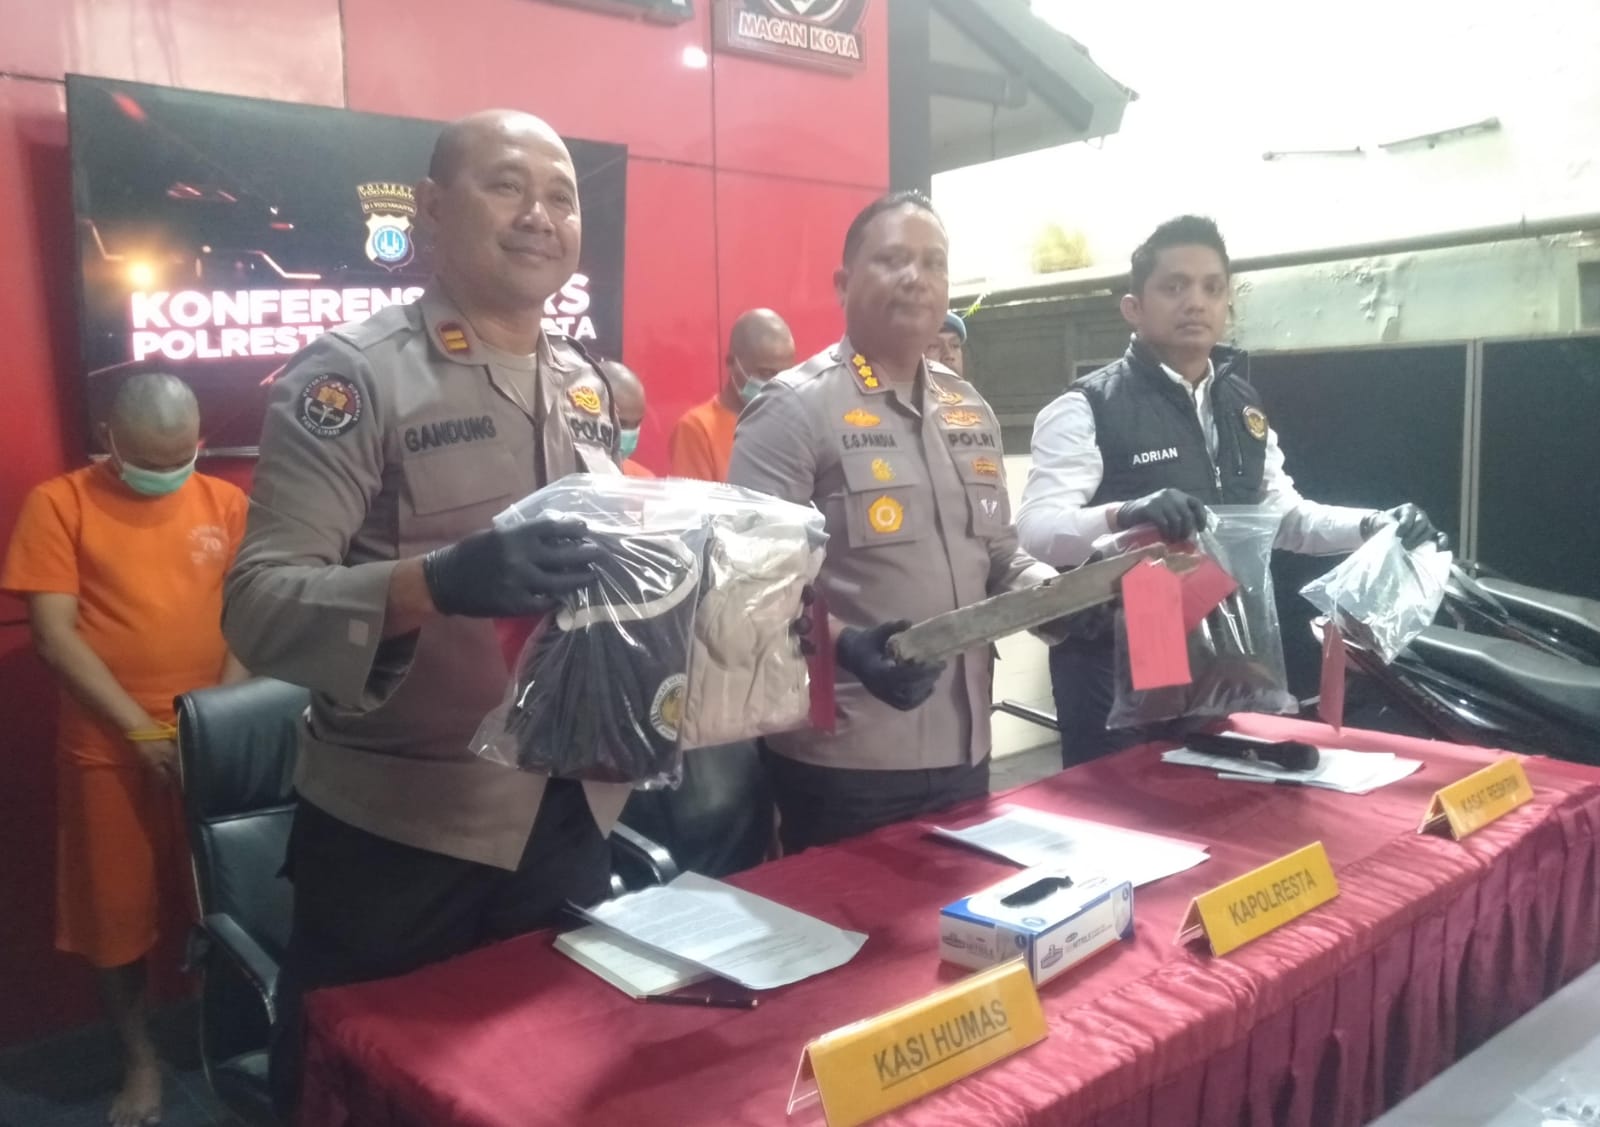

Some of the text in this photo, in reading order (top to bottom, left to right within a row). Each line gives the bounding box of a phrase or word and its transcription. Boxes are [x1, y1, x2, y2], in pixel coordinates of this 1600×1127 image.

[738, 11, 860, 59] MACAN KOTA
[404, 415, 497, 452] GANDUNG
[948, 432, 995, 448] POLRI
[1132, 447, 1179, 466] ADRIAN
[1228, 868, 1317, 926] KAPOLRESTA
[873, 999, 1008, 1083] KASI HUMAS
